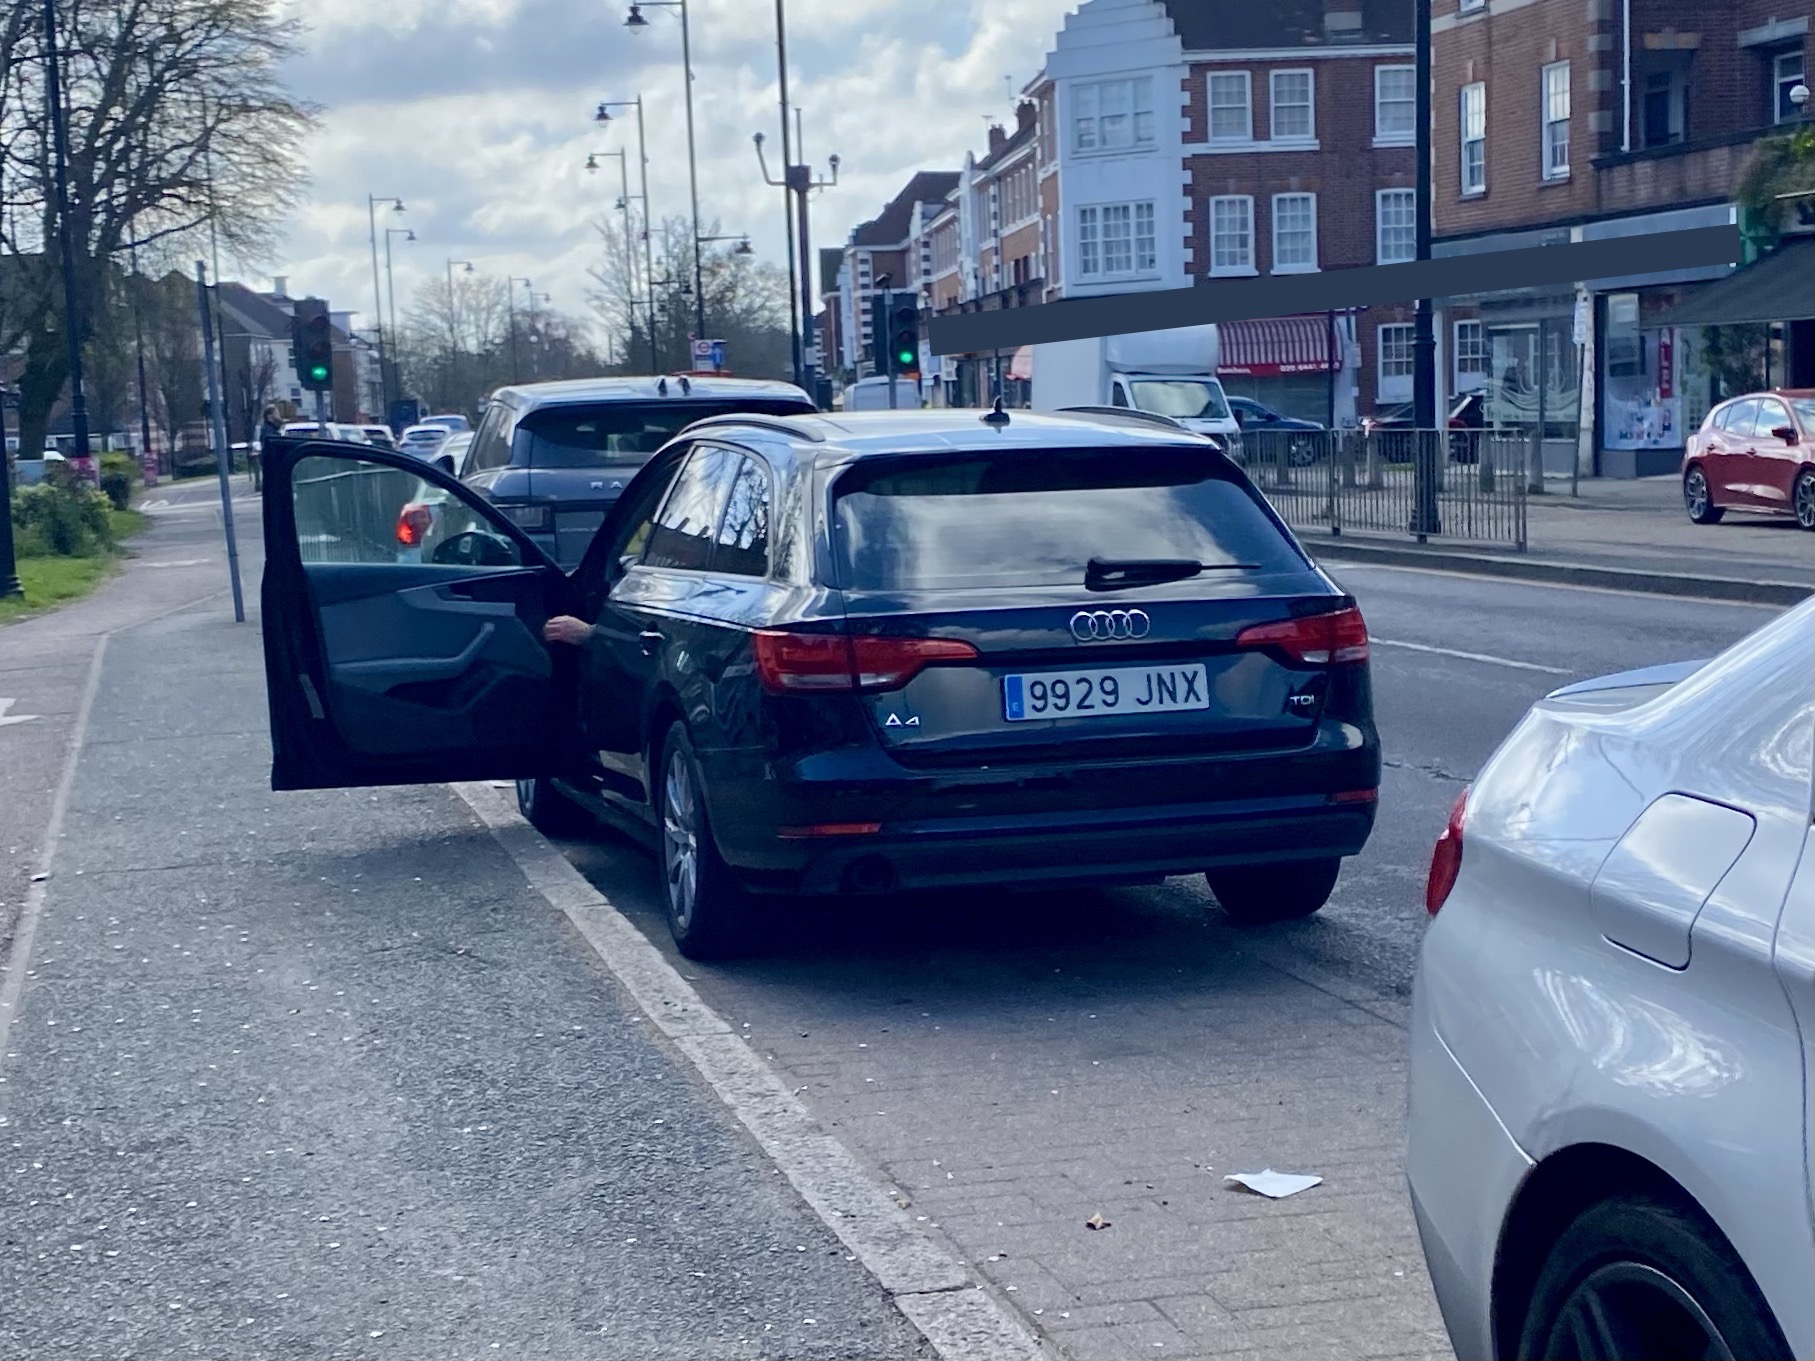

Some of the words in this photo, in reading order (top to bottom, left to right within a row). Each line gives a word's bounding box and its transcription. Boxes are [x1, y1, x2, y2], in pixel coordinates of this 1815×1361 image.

[1029, 675, 1120, 713] 9929
[1135, 670, 1202, 706] JNX
[1289, 694, 1315, 706] TDI
[885, 713, 920, 726] A4
